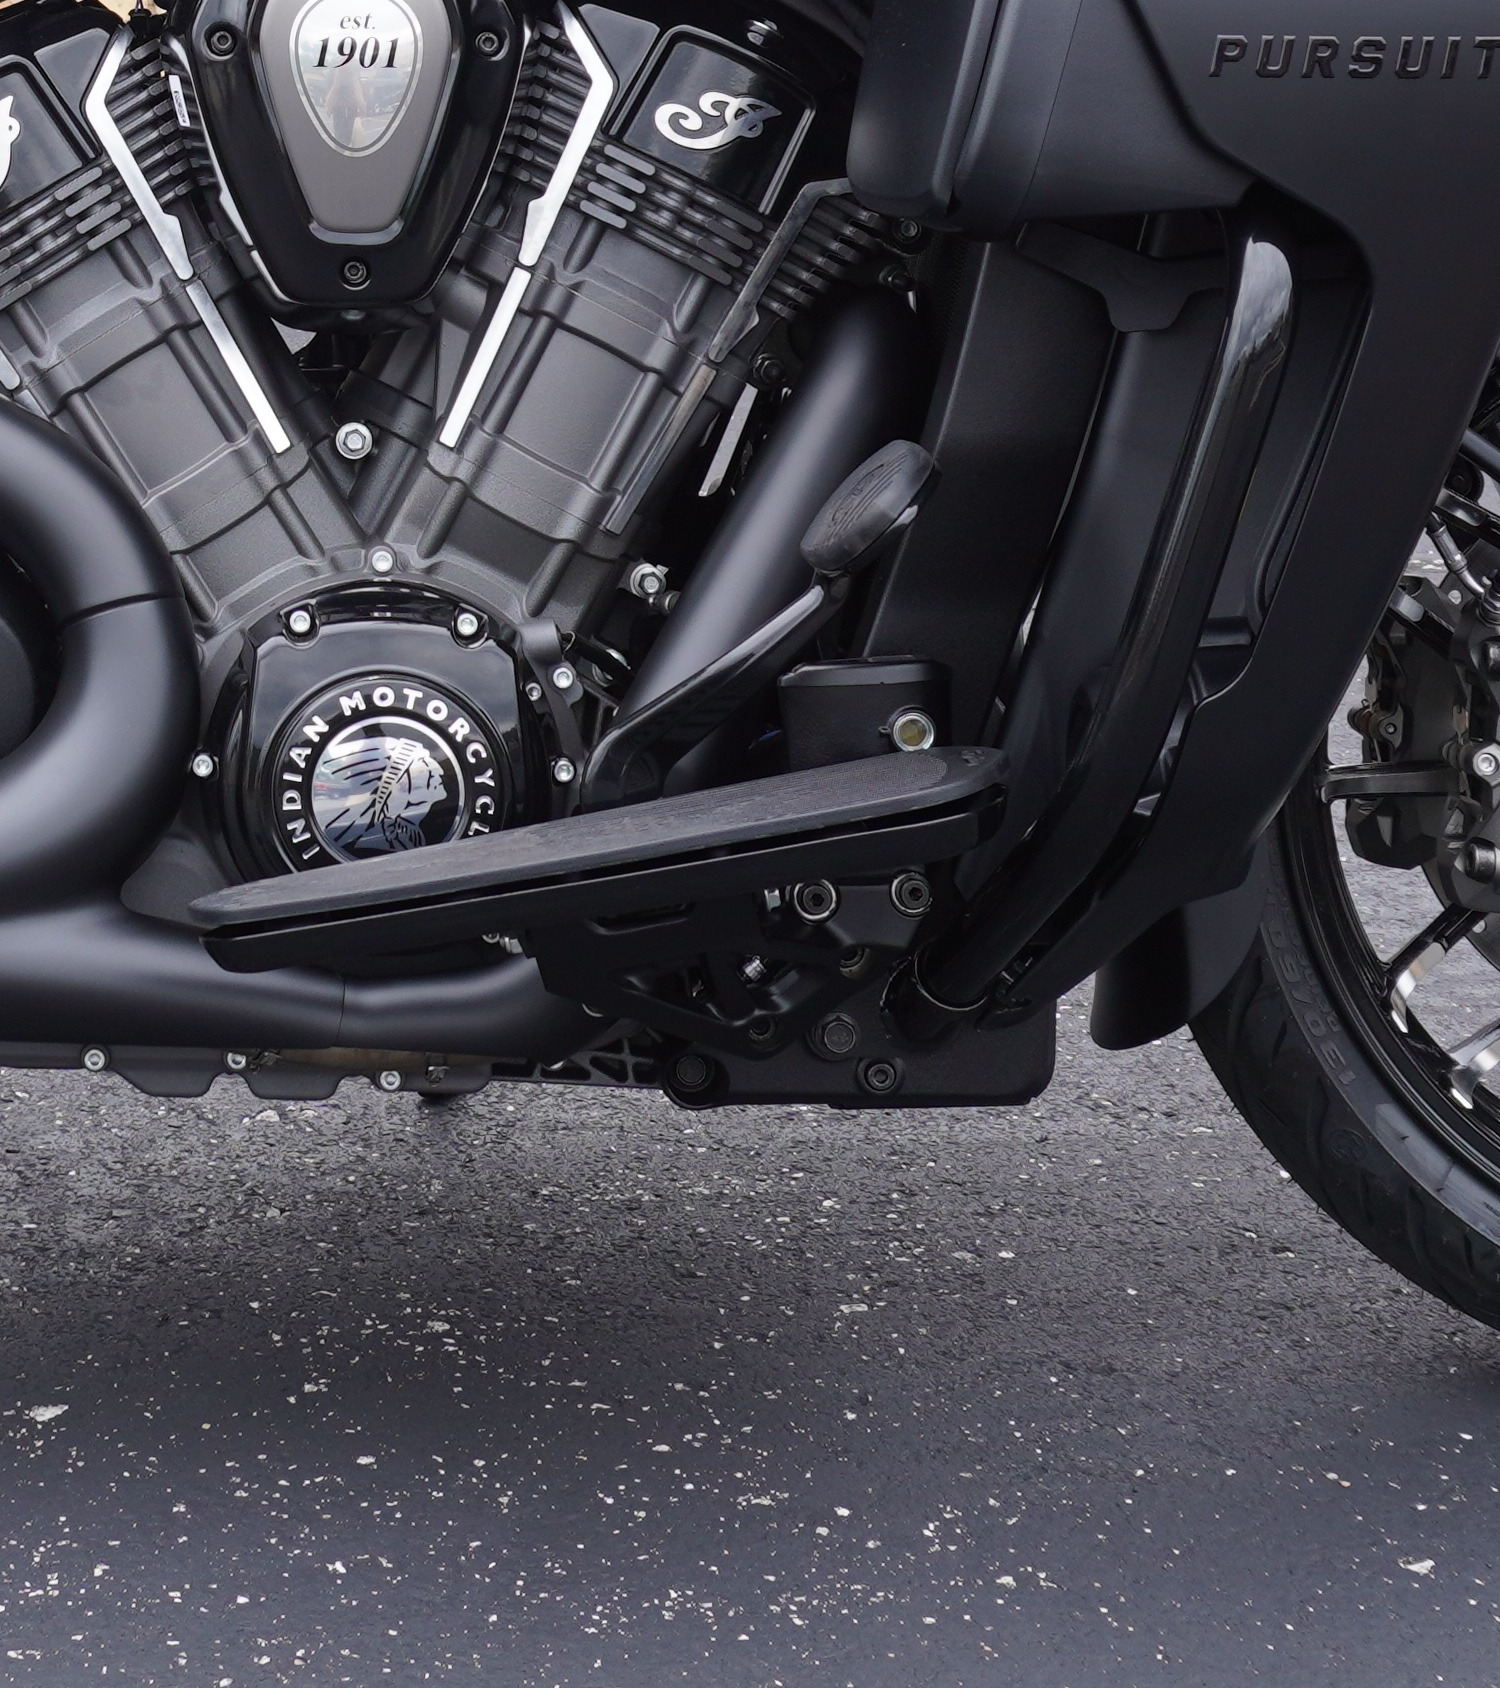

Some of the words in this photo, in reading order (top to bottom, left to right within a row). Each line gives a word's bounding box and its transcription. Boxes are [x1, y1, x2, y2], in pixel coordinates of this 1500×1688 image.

[339, 12, 376, 30] est.
[311, 35, 400, 69] 1901
[281, 714, 330, 860] INDIAN
[338, 685, 496, 837] MOTORCYCL
